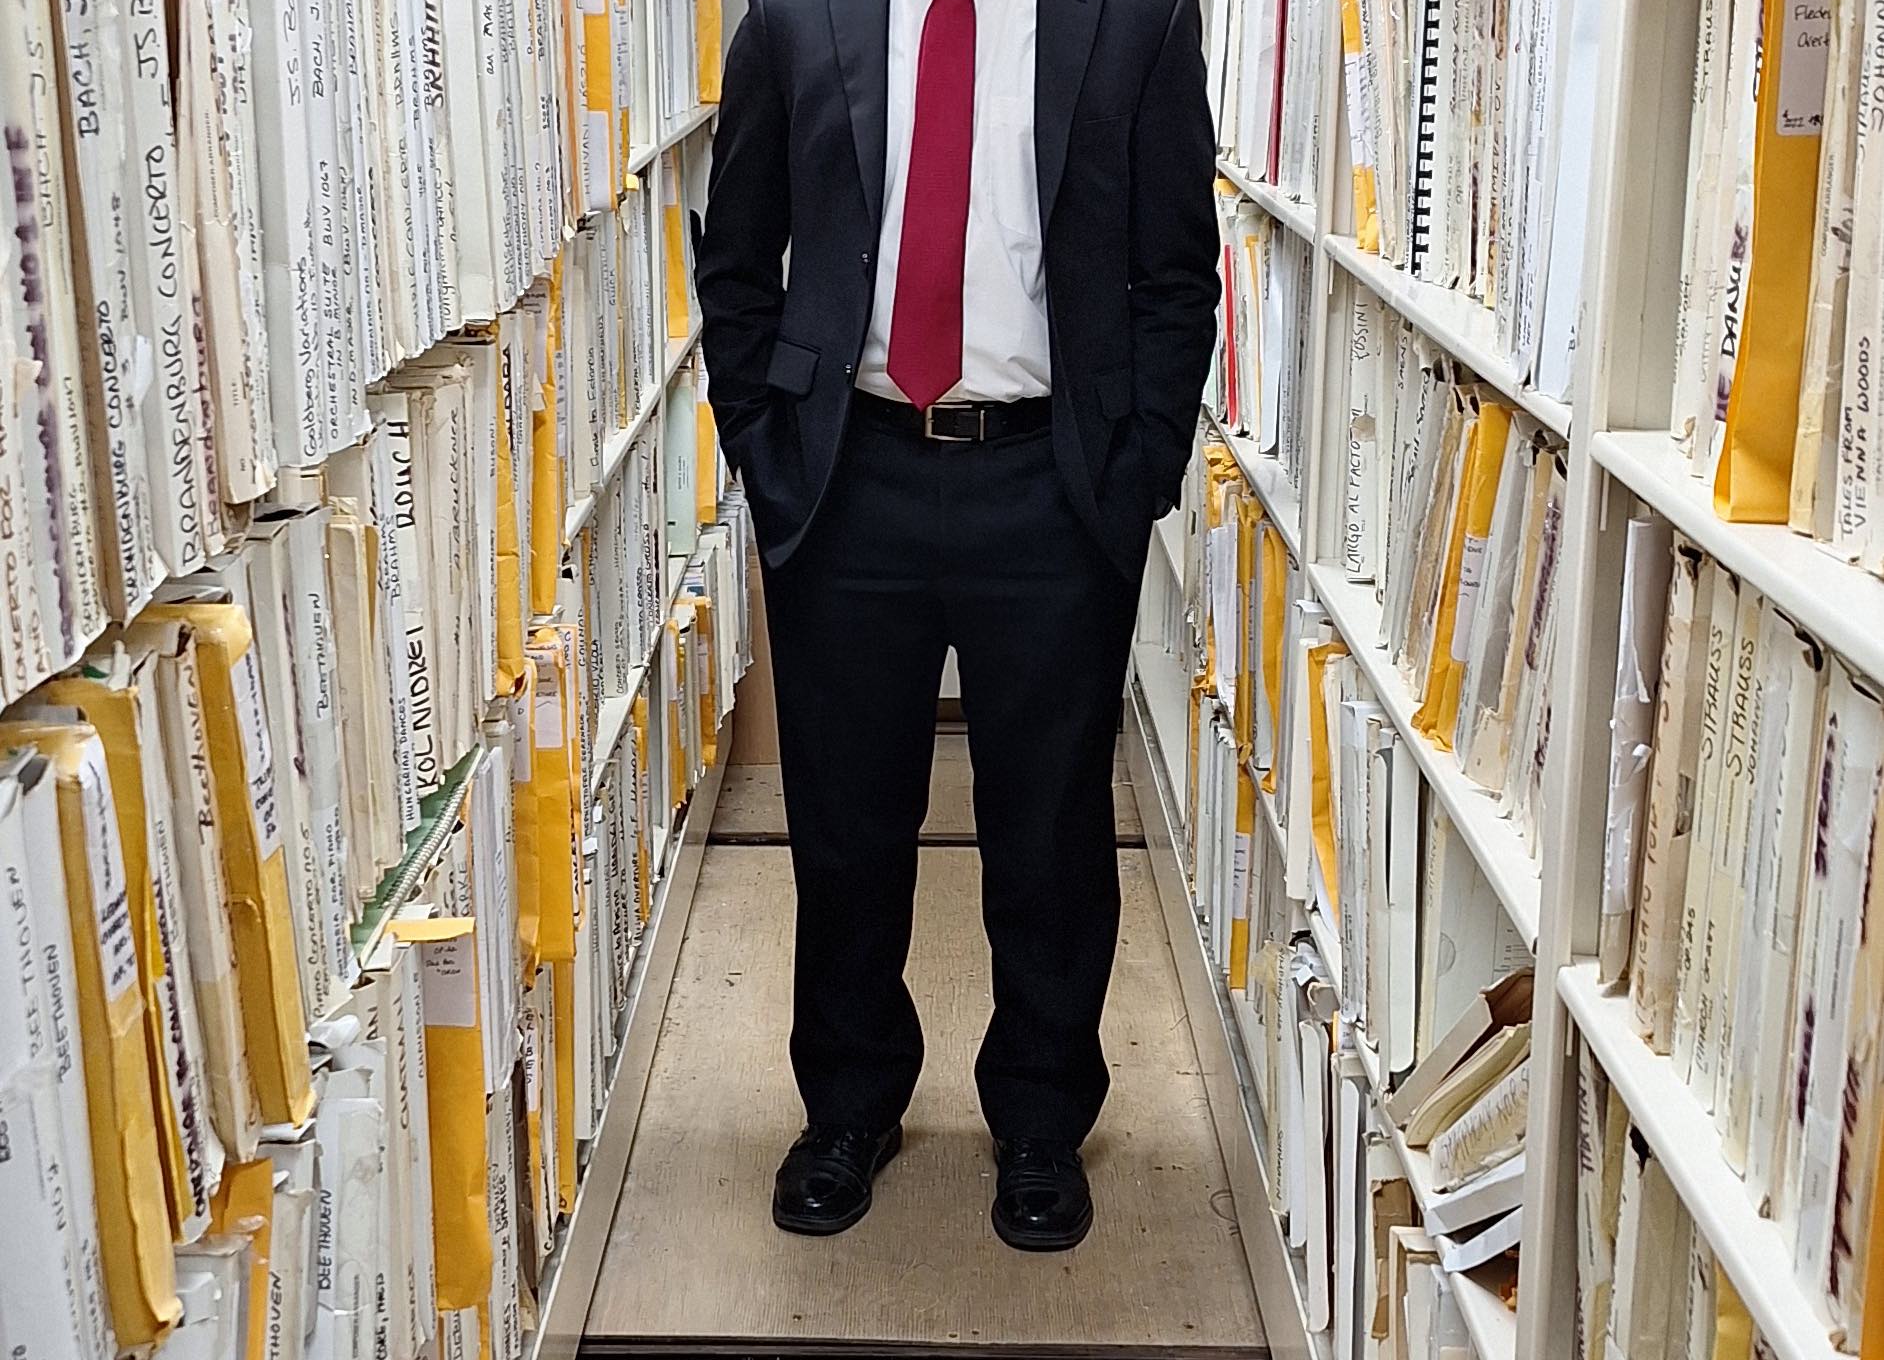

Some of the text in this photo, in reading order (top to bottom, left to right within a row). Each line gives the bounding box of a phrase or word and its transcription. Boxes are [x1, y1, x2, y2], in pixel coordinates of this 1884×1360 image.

[71, 28, 100, 137] BACH,
[146, 144, 179, 297] CONCERTO
[321, 261, 335, 320] SUITE
[325, 326, 340, 440] ORCHESTRAL
[1853, 336, 1871, 529] VIENNA WOODS
[1838, 406, 1856, 542] TALES FROM
[406, 624, 439, 790] KOL NIDREI
[1700, 624, 1724, 763] STRAUSS
[1726, 636, 1756, 778] STRAUSS
[43, 943, 71, 1083] BEETHOVEN
